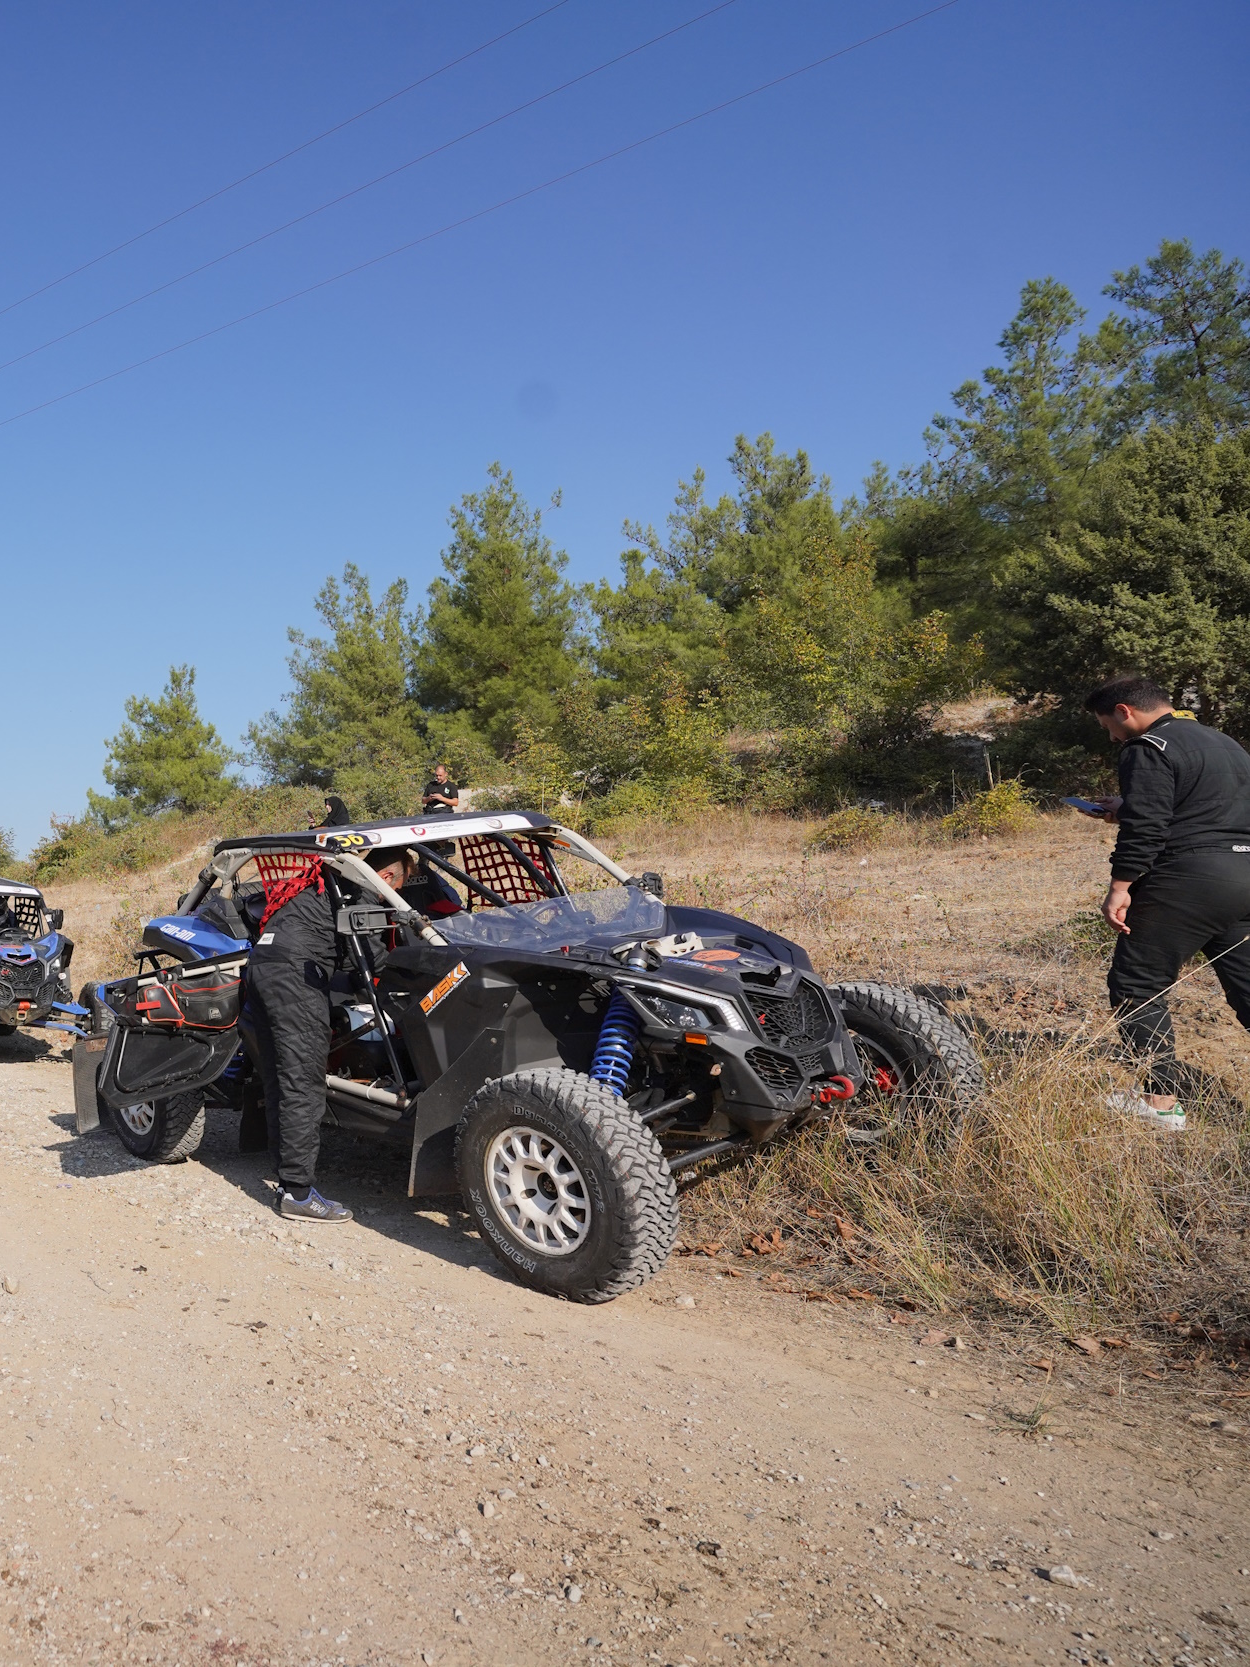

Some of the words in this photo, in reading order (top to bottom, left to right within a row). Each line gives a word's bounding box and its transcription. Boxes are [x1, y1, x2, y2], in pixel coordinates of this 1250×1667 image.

[335, 833, 364, 847] 56
[404, 875, 428, 886] parco
[160, 923, 196, 941] can-am
[513, 1105, 584, 1160] Dynapro
[469, 1188, 537, 1273] Hankook
